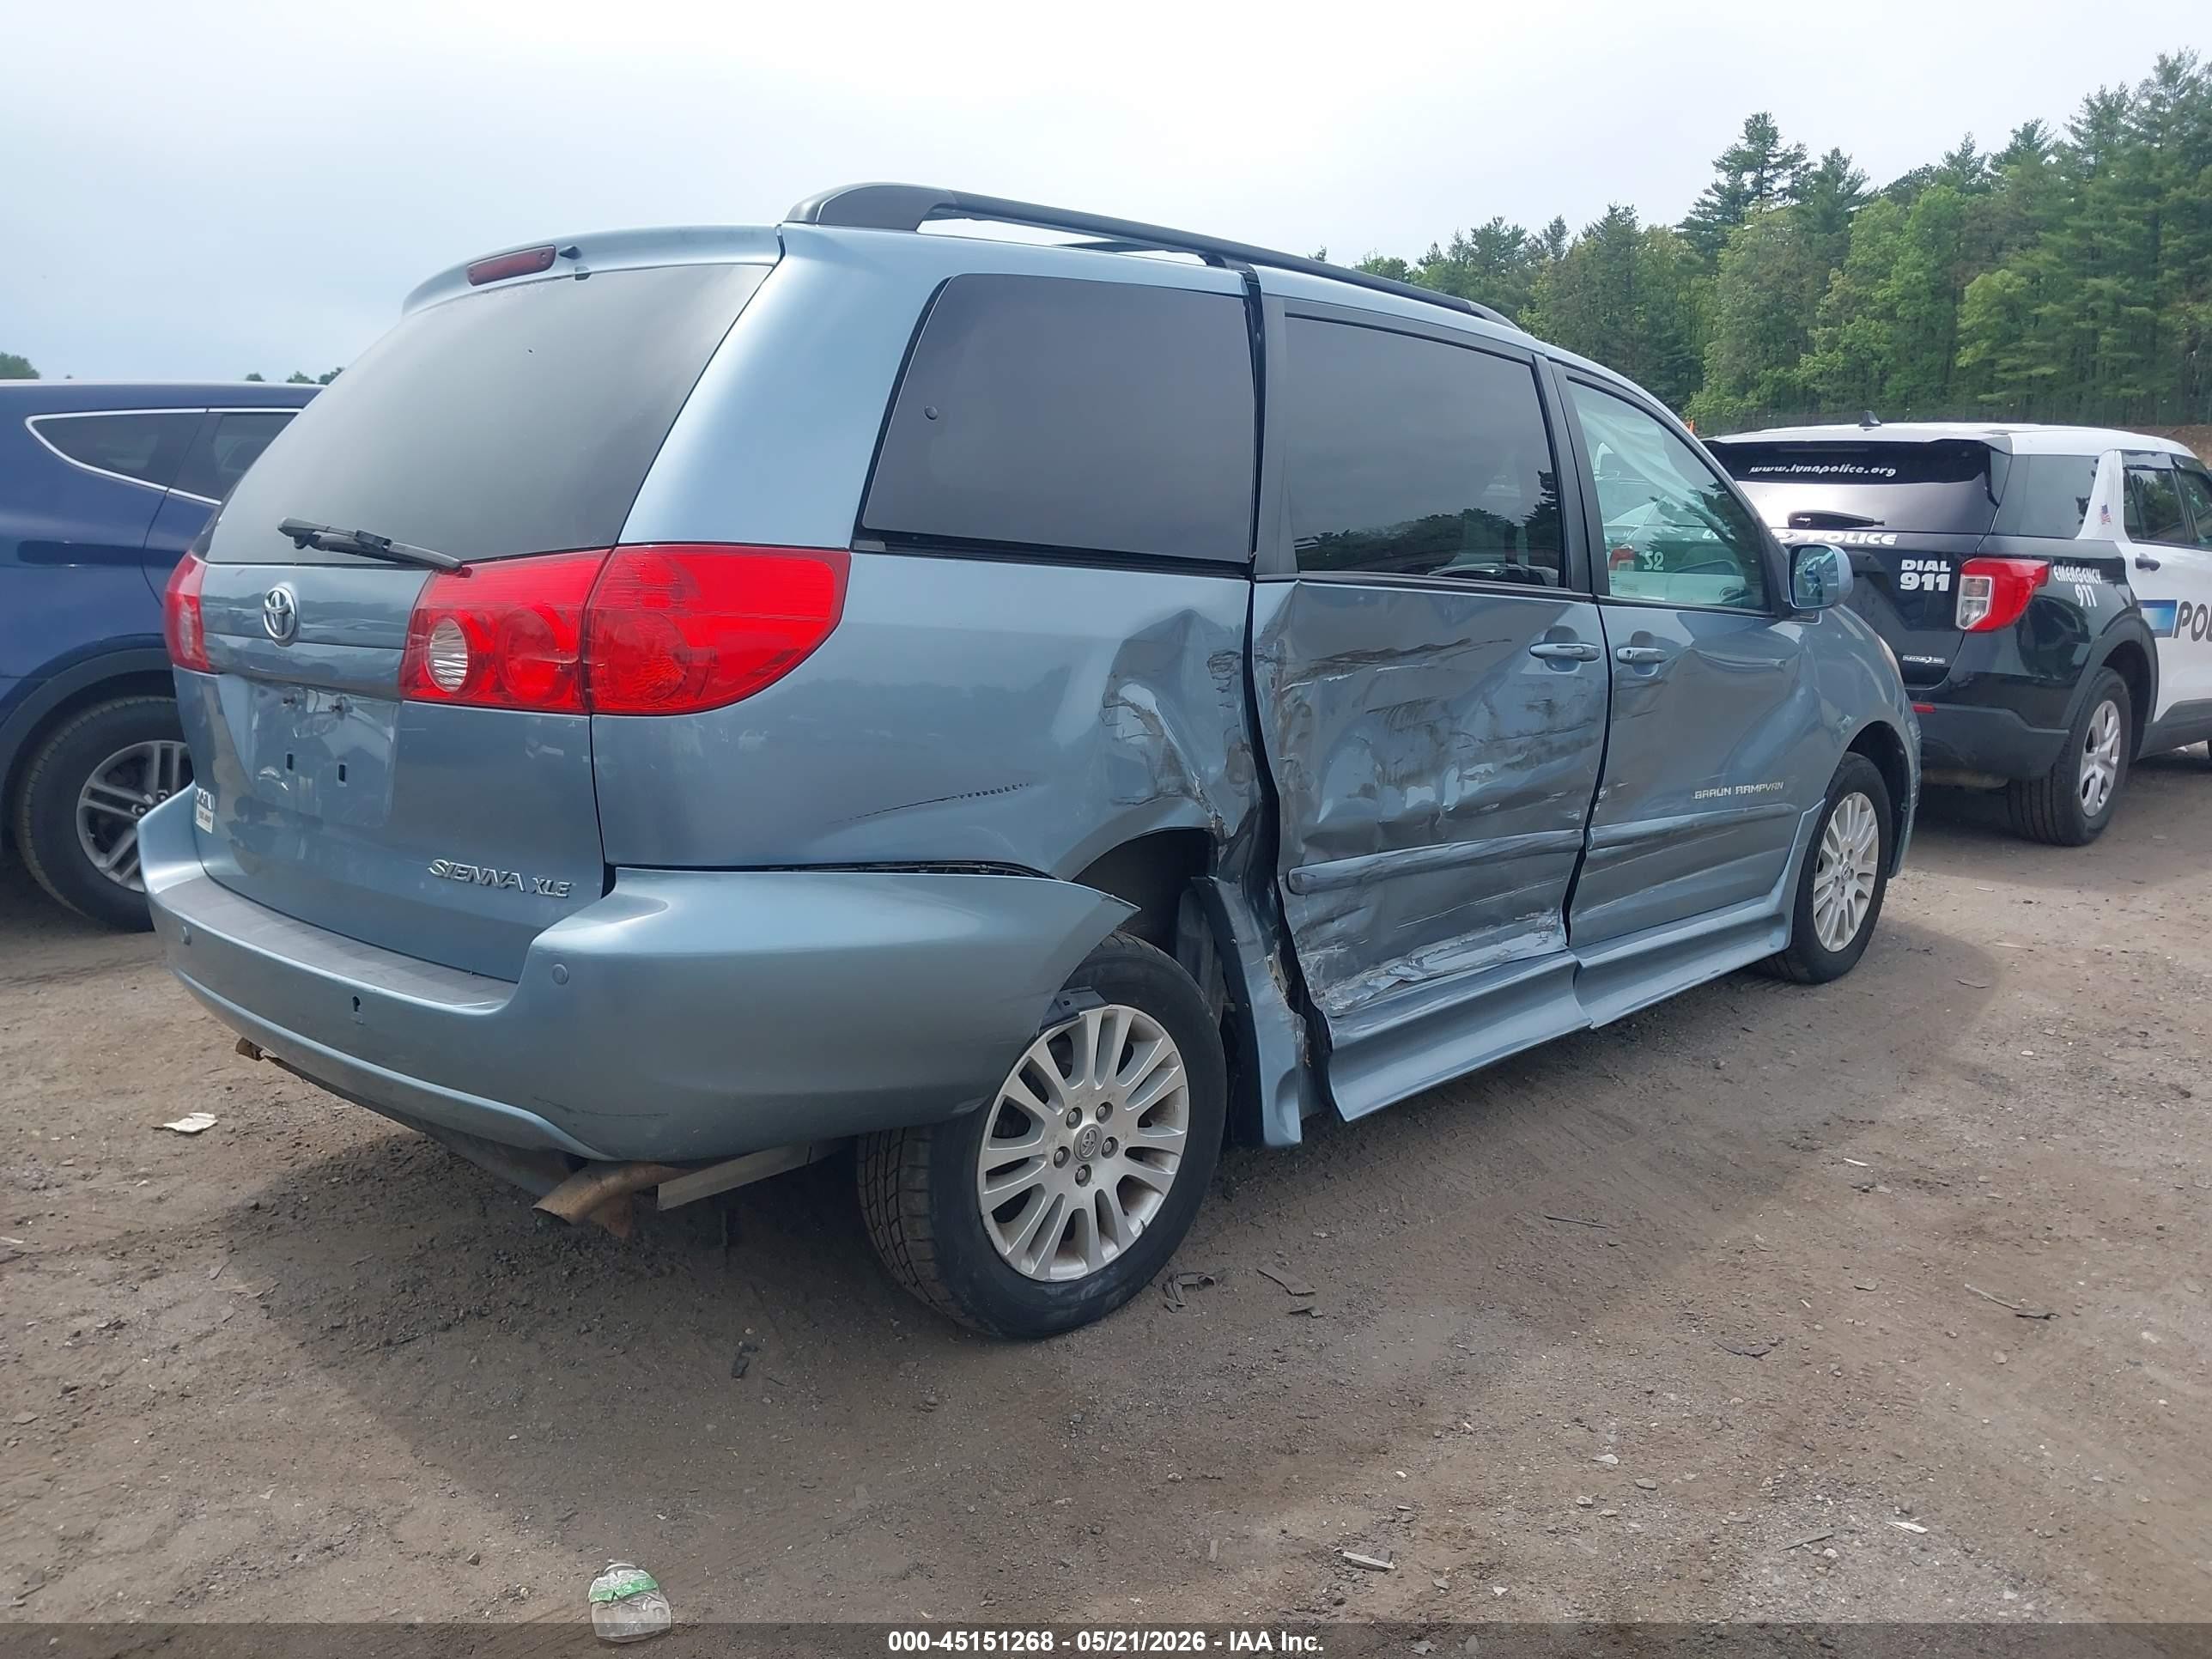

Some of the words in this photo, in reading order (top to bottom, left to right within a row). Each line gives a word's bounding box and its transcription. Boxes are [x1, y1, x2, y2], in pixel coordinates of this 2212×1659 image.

[1748, 463, 1897, 477] www.lynnpolice.org
[1807, 532, 1898, 545] POLICE
[1901, 559, 1951, 573] DIAL
[2053, 564, 2102, 585] EMERGENCY
[1899, 573, 1950, 592] 911
[2075, 585, 2098, 608] 911
[1694, 787, 1732, 799] BRAUN
[1735, 781, 1784, 795] RAMPVAN
[428, 859, 526, 892] SIENNA
[532, 878, 571, 898] XLE
